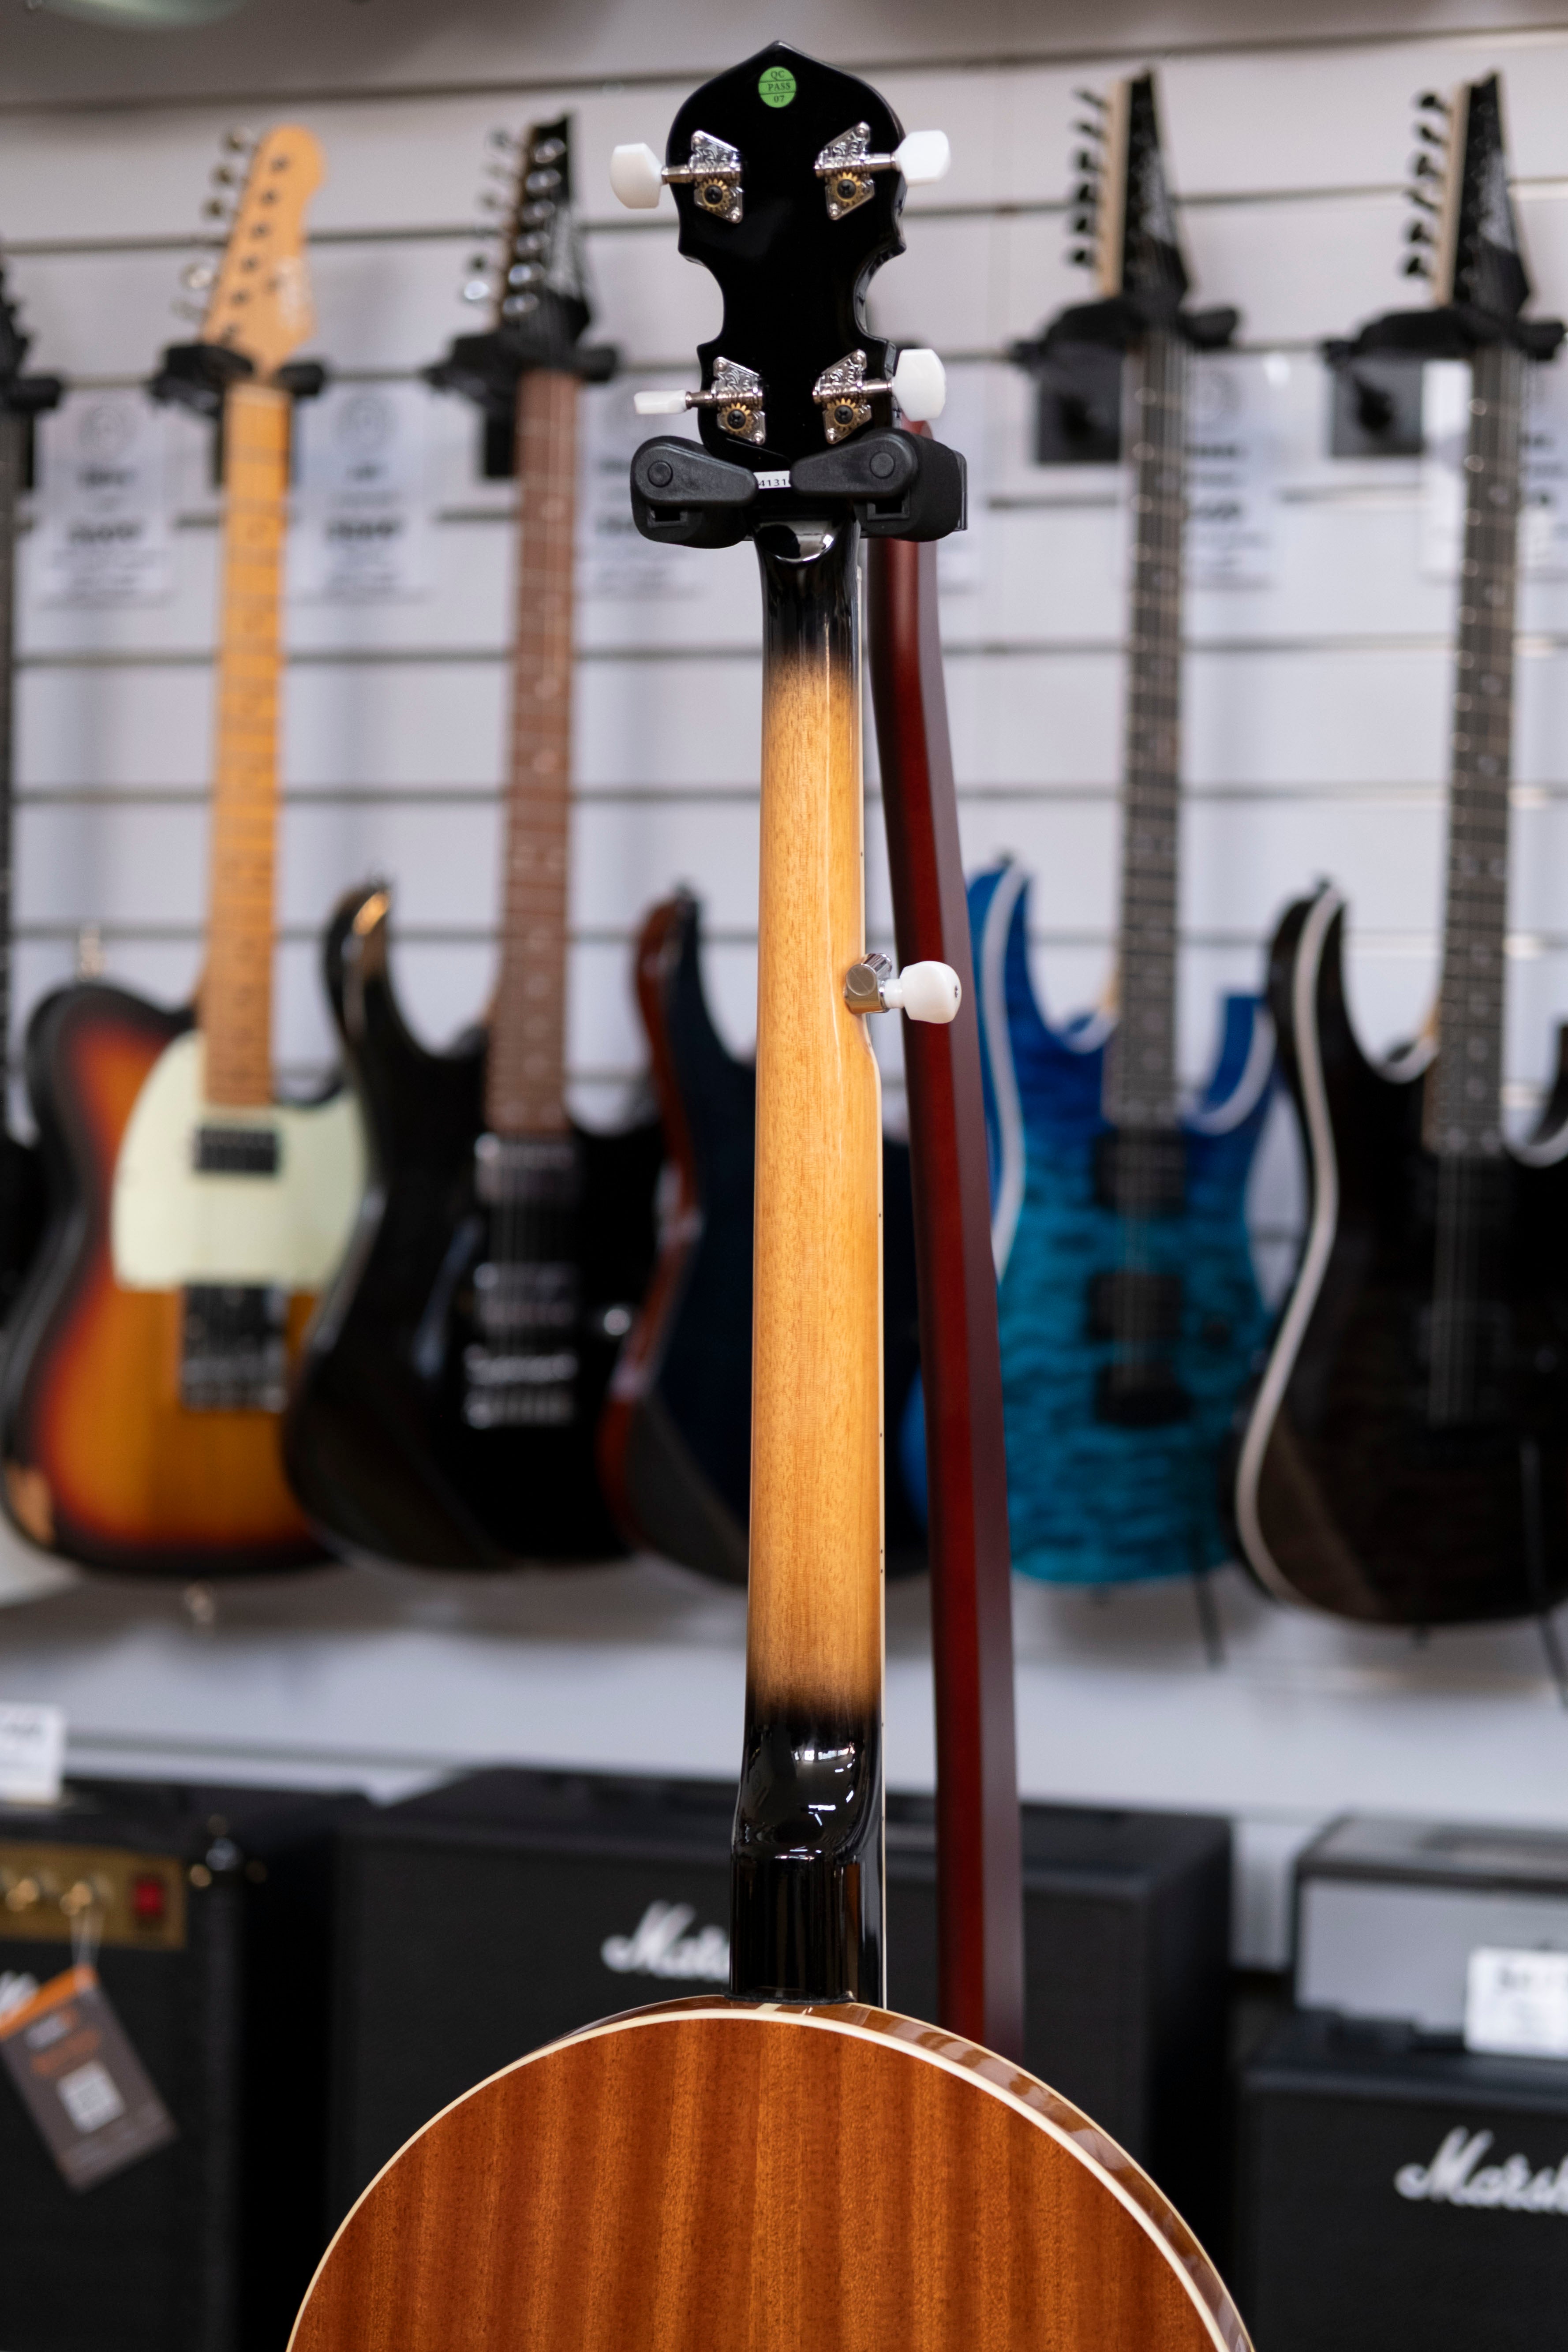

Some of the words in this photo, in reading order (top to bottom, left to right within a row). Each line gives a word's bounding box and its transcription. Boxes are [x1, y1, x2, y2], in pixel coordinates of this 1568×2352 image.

[771, 71, 784, 80] QC
[768, 82, 791, 91] PASS
[759, 479, 790, 487] 4131
